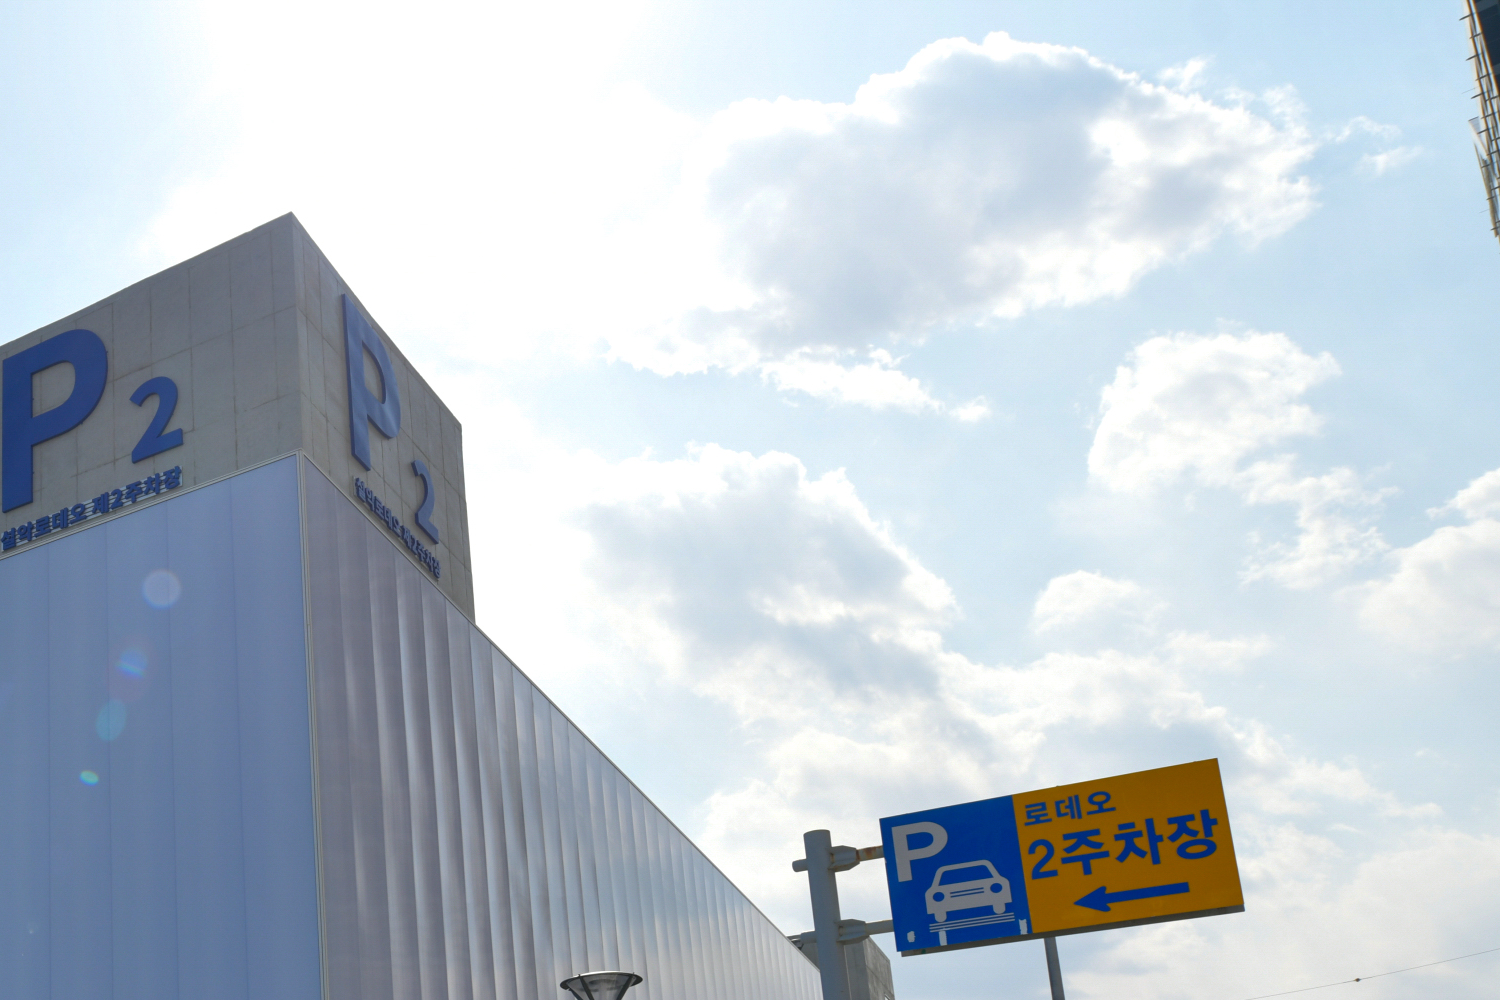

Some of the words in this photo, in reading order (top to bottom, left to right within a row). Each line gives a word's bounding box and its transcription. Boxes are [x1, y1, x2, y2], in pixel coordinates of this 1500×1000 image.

[2, 329, 109, 513] P
[129, 376, 184, 464] 2
[342, 293, 401, 471] P
[411, 460, 439, 545] 2
[1, 503, 88, 550] 설악로데오
[92, 466, 182, 514] 제2주차장
[1024, 790, 1117, 827] 로데오
[1028, 809, 1218, 880] 2주차장
[891, 821, 948, 882] P
